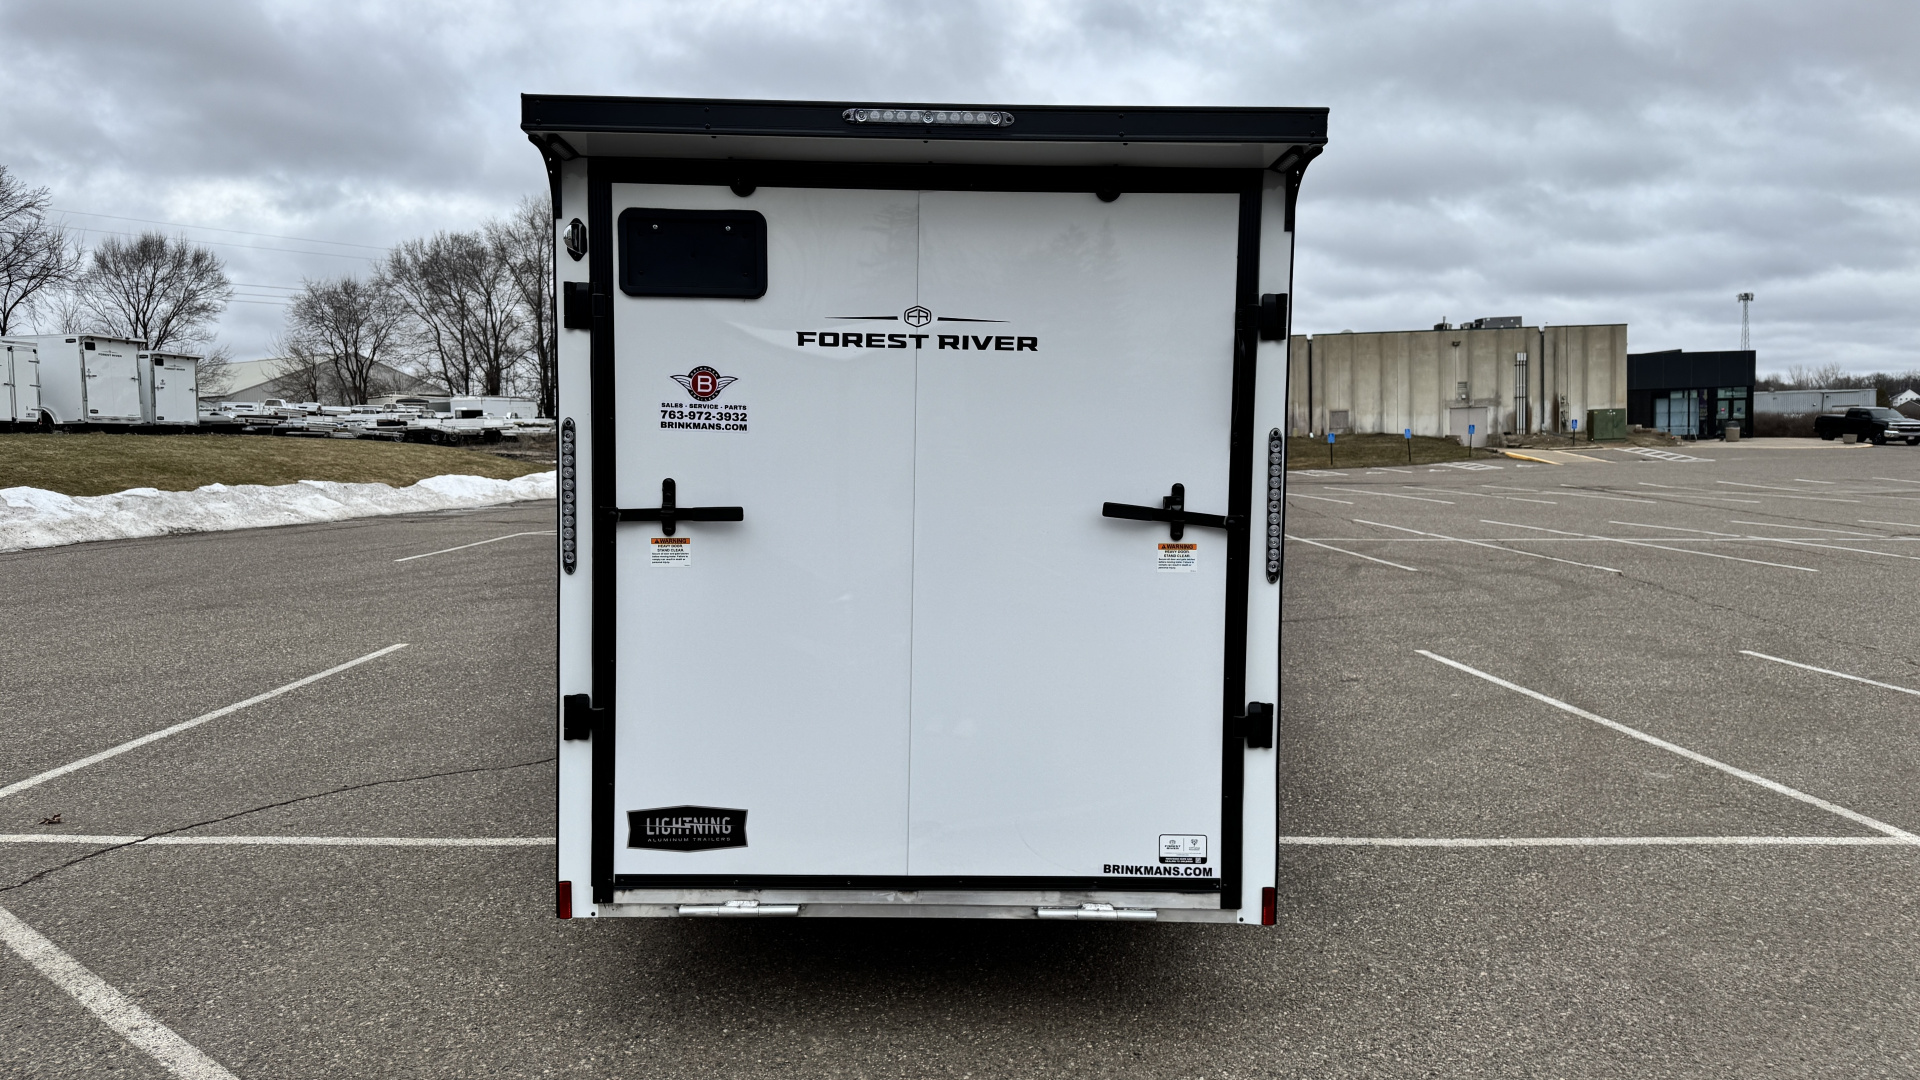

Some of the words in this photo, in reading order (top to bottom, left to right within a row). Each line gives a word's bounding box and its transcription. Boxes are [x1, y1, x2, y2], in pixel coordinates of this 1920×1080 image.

[796, 331, 929, 349] FOREST
[937, 334, 1038, 351] RIVER
[697, 375, 713, 393] B
[660, 410, 748, 422] 763-972-3932
[660, 421, 748, 431] BRINKMANS.COM
[646, 817, 732, 835] LIGHTNING
[1103, 864, 1213, 877] BRINKMANS.COM
